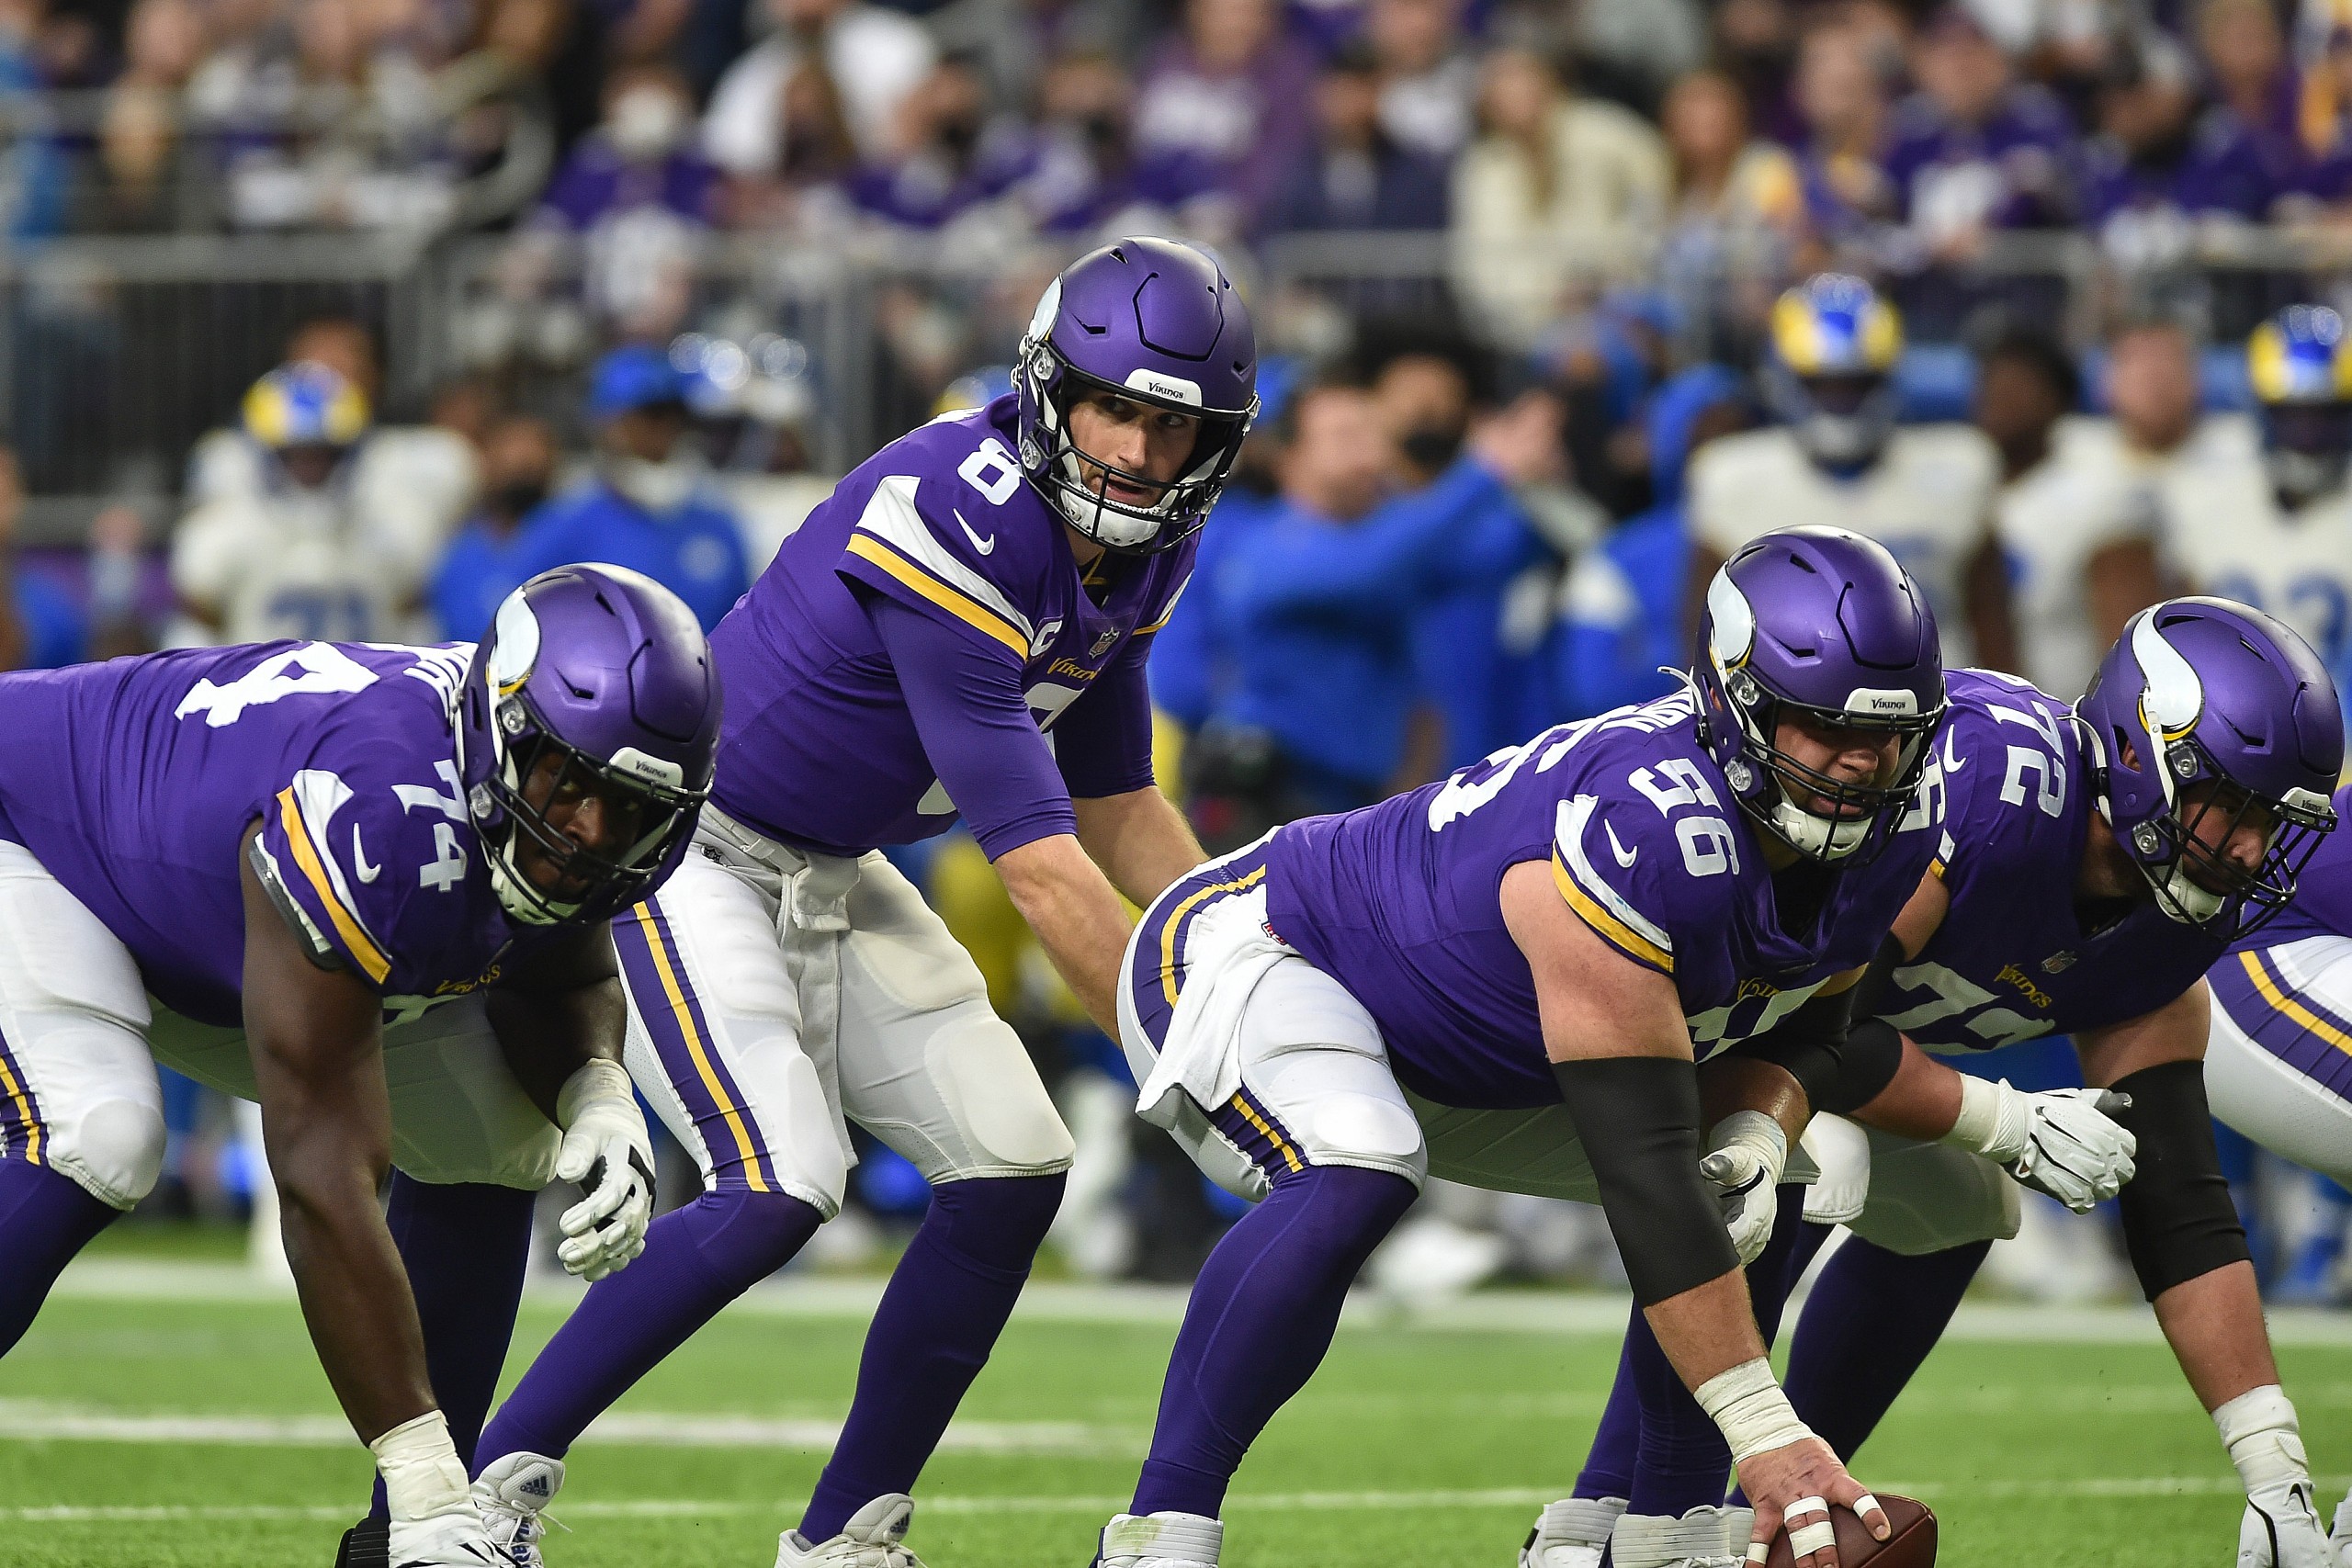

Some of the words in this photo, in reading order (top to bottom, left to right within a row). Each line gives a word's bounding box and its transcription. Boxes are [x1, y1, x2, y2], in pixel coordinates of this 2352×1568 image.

[957, 437, 1023, 506] 8
[175, 641, 380, 728] 4
[1628, 758, 1740, 877] 56
[1985, 700, 2067, 818] 72
[390, 759, 470, 893] 74
